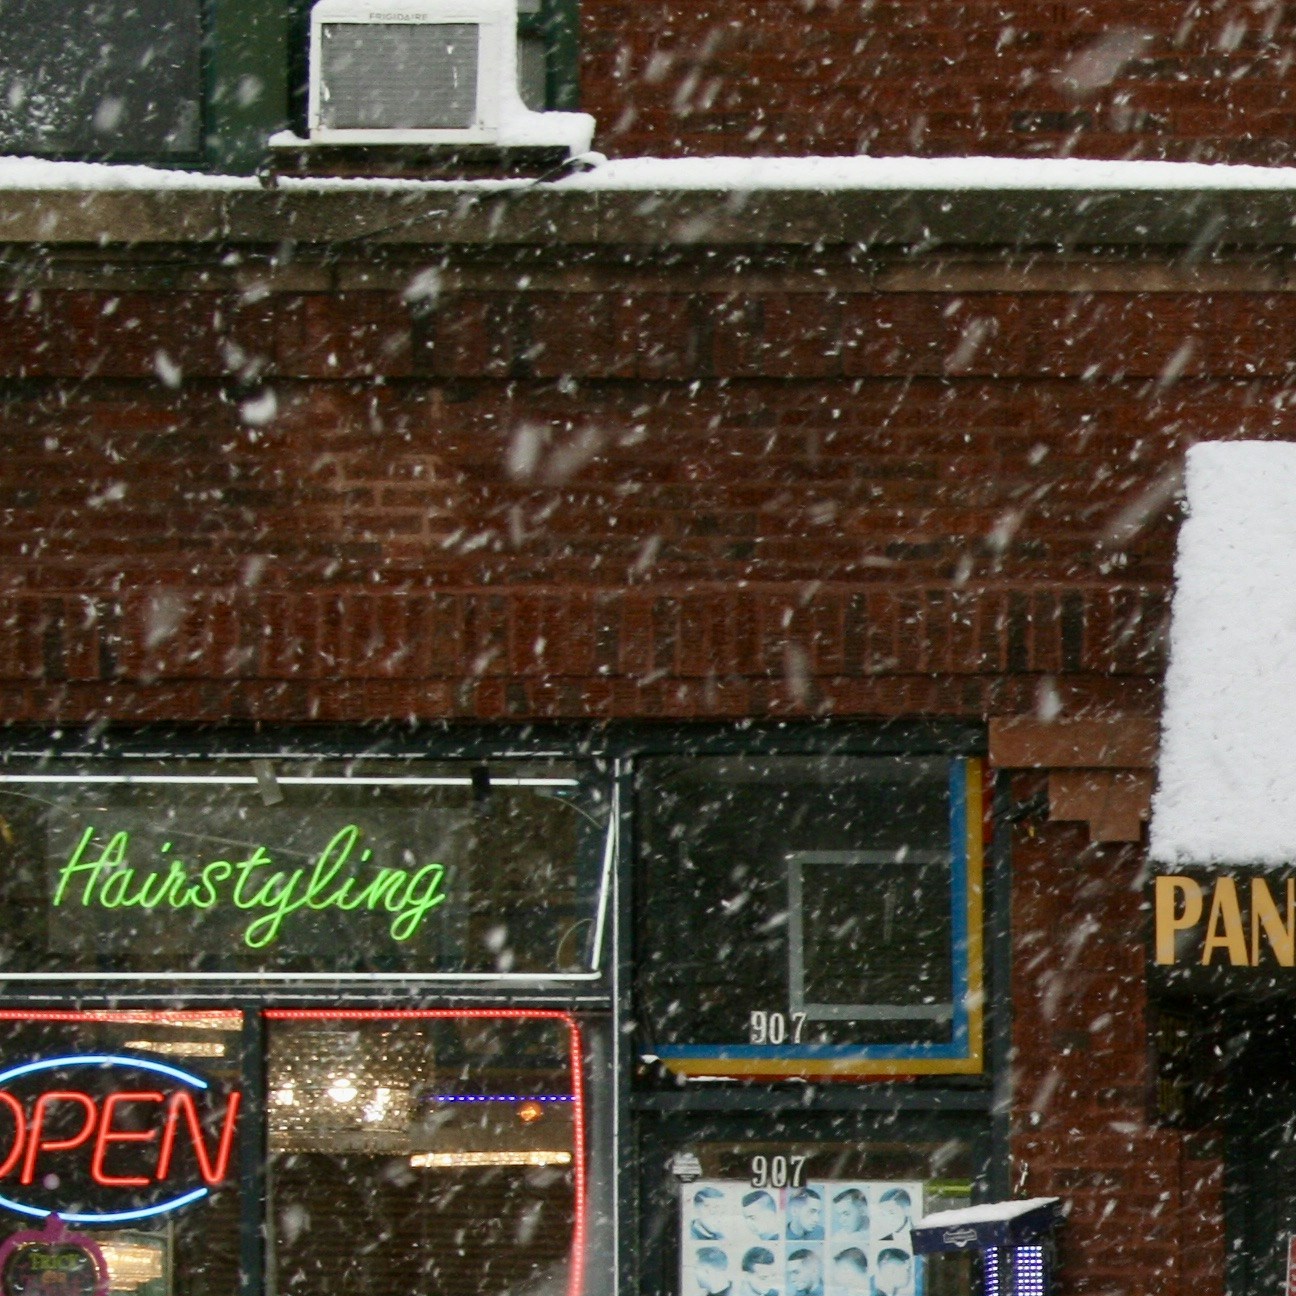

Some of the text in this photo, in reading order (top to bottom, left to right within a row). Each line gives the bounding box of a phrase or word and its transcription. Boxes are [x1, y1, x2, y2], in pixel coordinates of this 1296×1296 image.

[52, 824, 447, 949] Hairstyling
[750, 1011, 808, 1045] 907
[751, 1155, 807, 1189] 907
